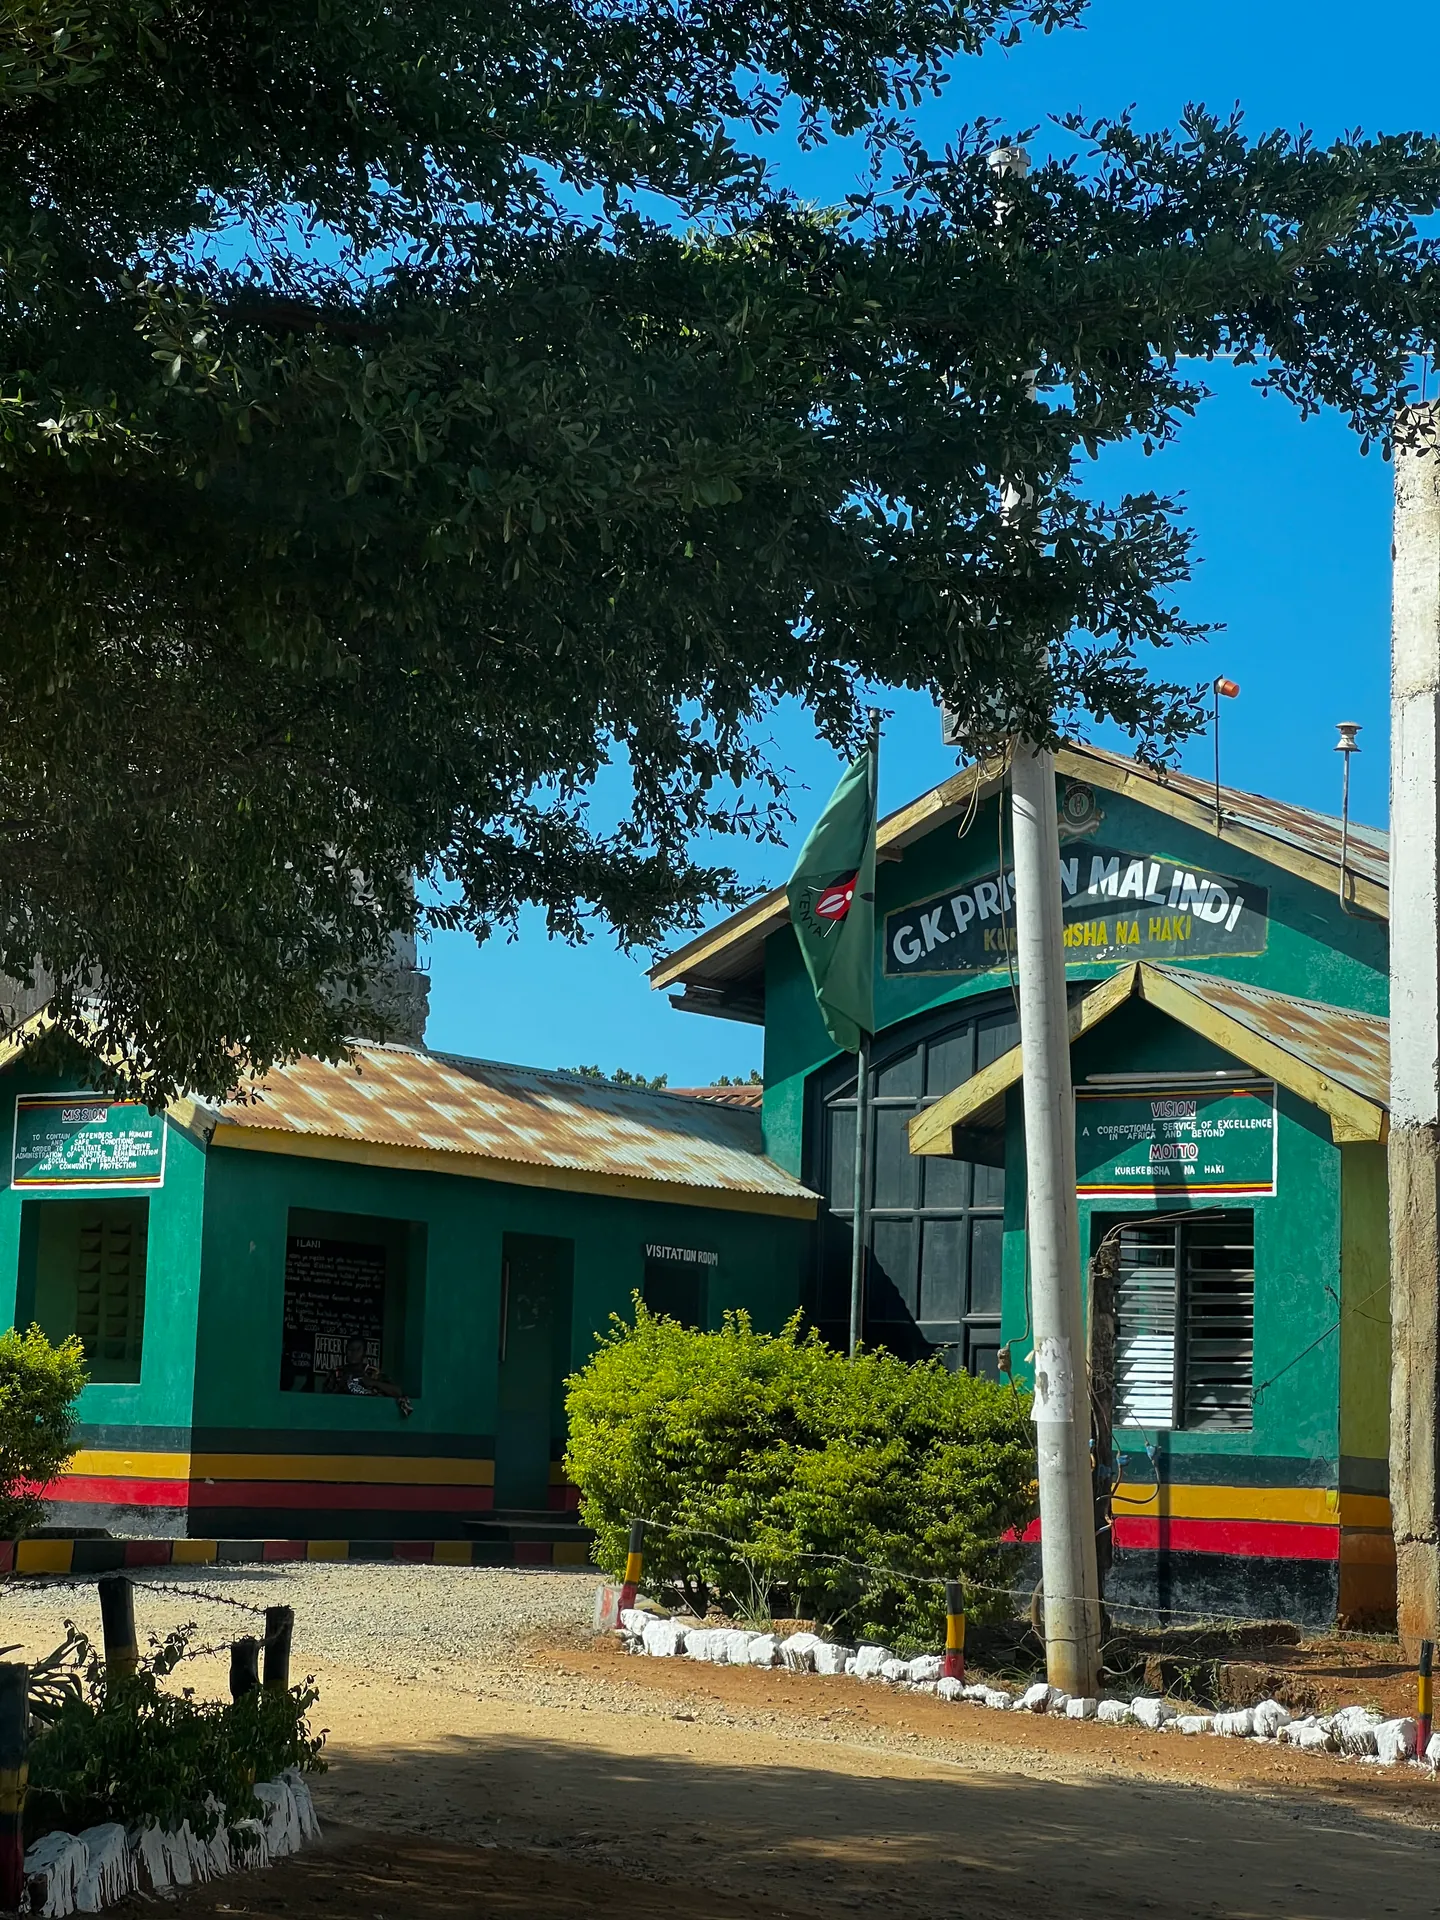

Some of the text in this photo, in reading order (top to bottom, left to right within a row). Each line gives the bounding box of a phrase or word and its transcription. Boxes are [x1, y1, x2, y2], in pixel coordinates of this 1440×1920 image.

[1087, 855, 1245, 933] MALINDI
[798, 888, 823, 938] KENYA
[1115, 919, 1141, 945] NA
[1148, 914, 1192, 942] HAKI
[62, 1108, 108, 1122] MISSION
[1151, 1100, 1197, 1118] VISION
[1082, 1118, 1273, 1136] A CORRECTIONAL SERVICE OF EXCELLENCE
[77, 1131, 113, 1140] OFFENDERS
[1109, 1128, 1225, 1141] IN AFRICA AND BEYOND
[70, 1144, 102, 1152] FACILITATE
[100, 1138, 134, 1146] CONDITIONS
[15, 1151, 63, 1160] ADMINISTRATION
[81, 1150, 107, 1158] JUSTICE
[1149, 1142, 1199, 1160] MOTTO
[38, 1163, 53, 1171] AND
[99, 1161, 137, 1171] PROTECTION
[1114, 1164, 1225, 1176] KUREKEBISHA NA HAKI
[296, 1239, 321, 1248] ILANI
[645, 1244, 718, 1266] VISITATION ROOM
[315, 1336, 342, 1354] OFFICER
